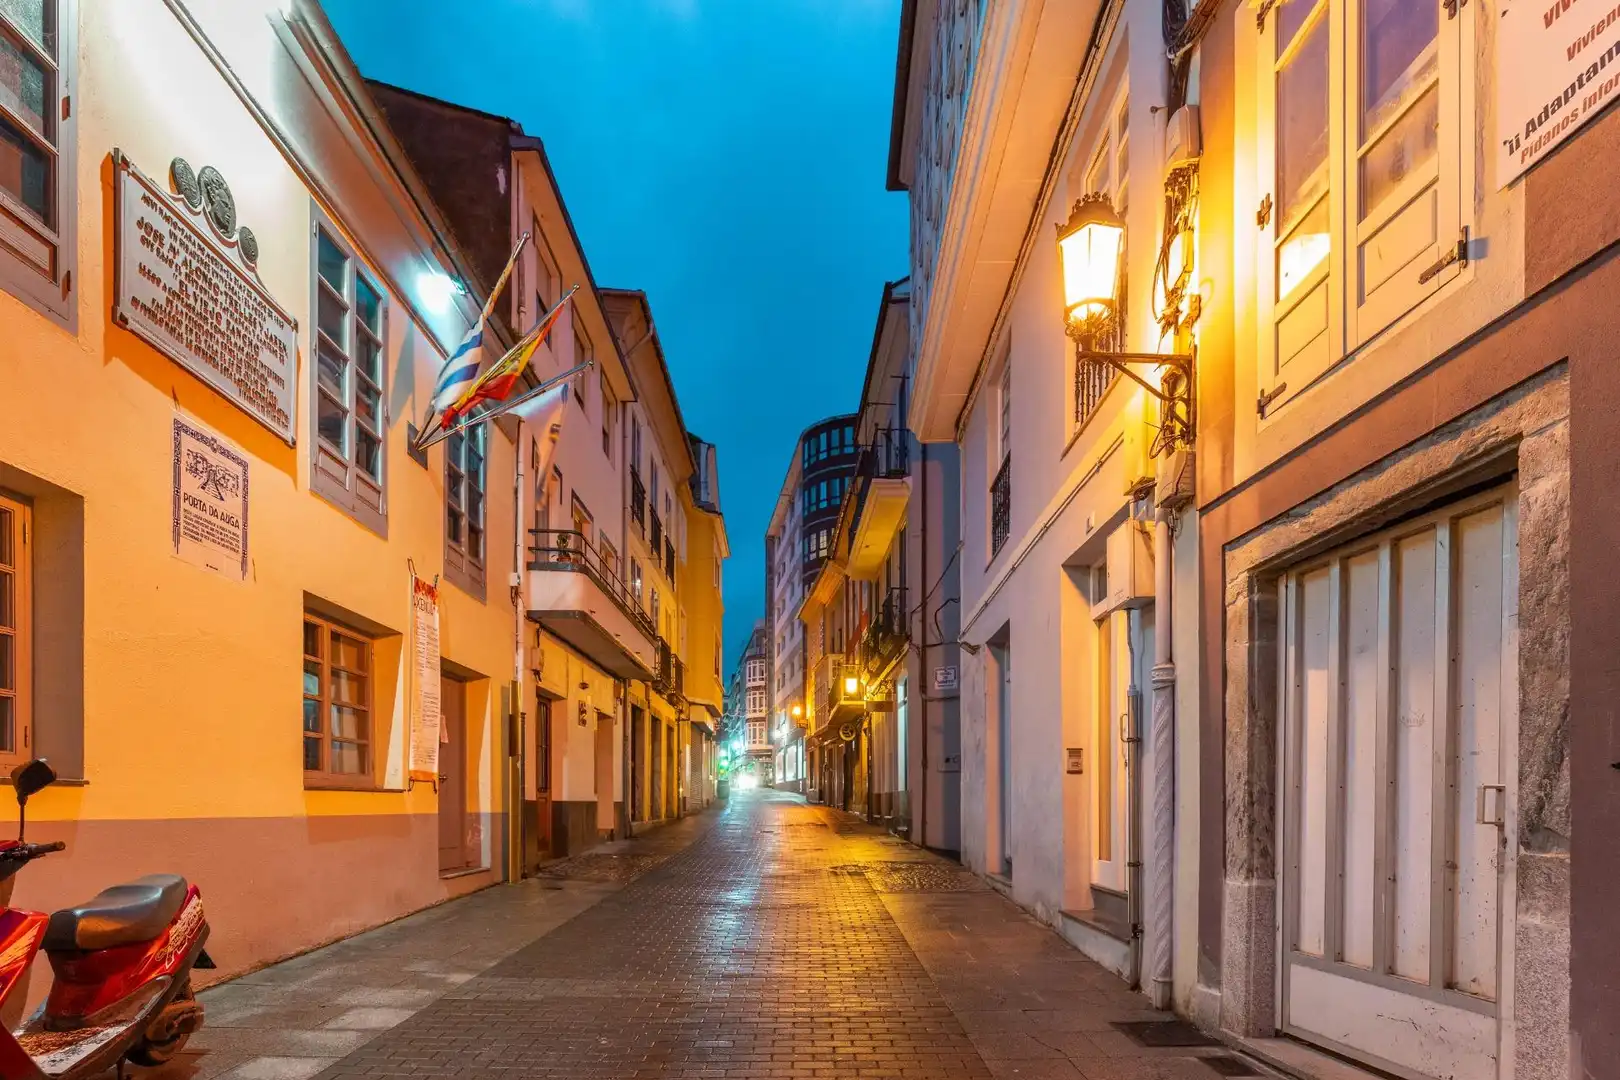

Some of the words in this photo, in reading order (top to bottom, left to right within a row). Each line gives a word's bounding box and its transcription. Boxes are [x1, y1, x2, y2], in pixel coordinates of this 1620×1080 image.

[1543, 0, 1578, 30] VIV
[183, 492, 207, 514] PORTA
[209, 505, 219, 519] DA
[220, 511, 240, 530] AUGA
